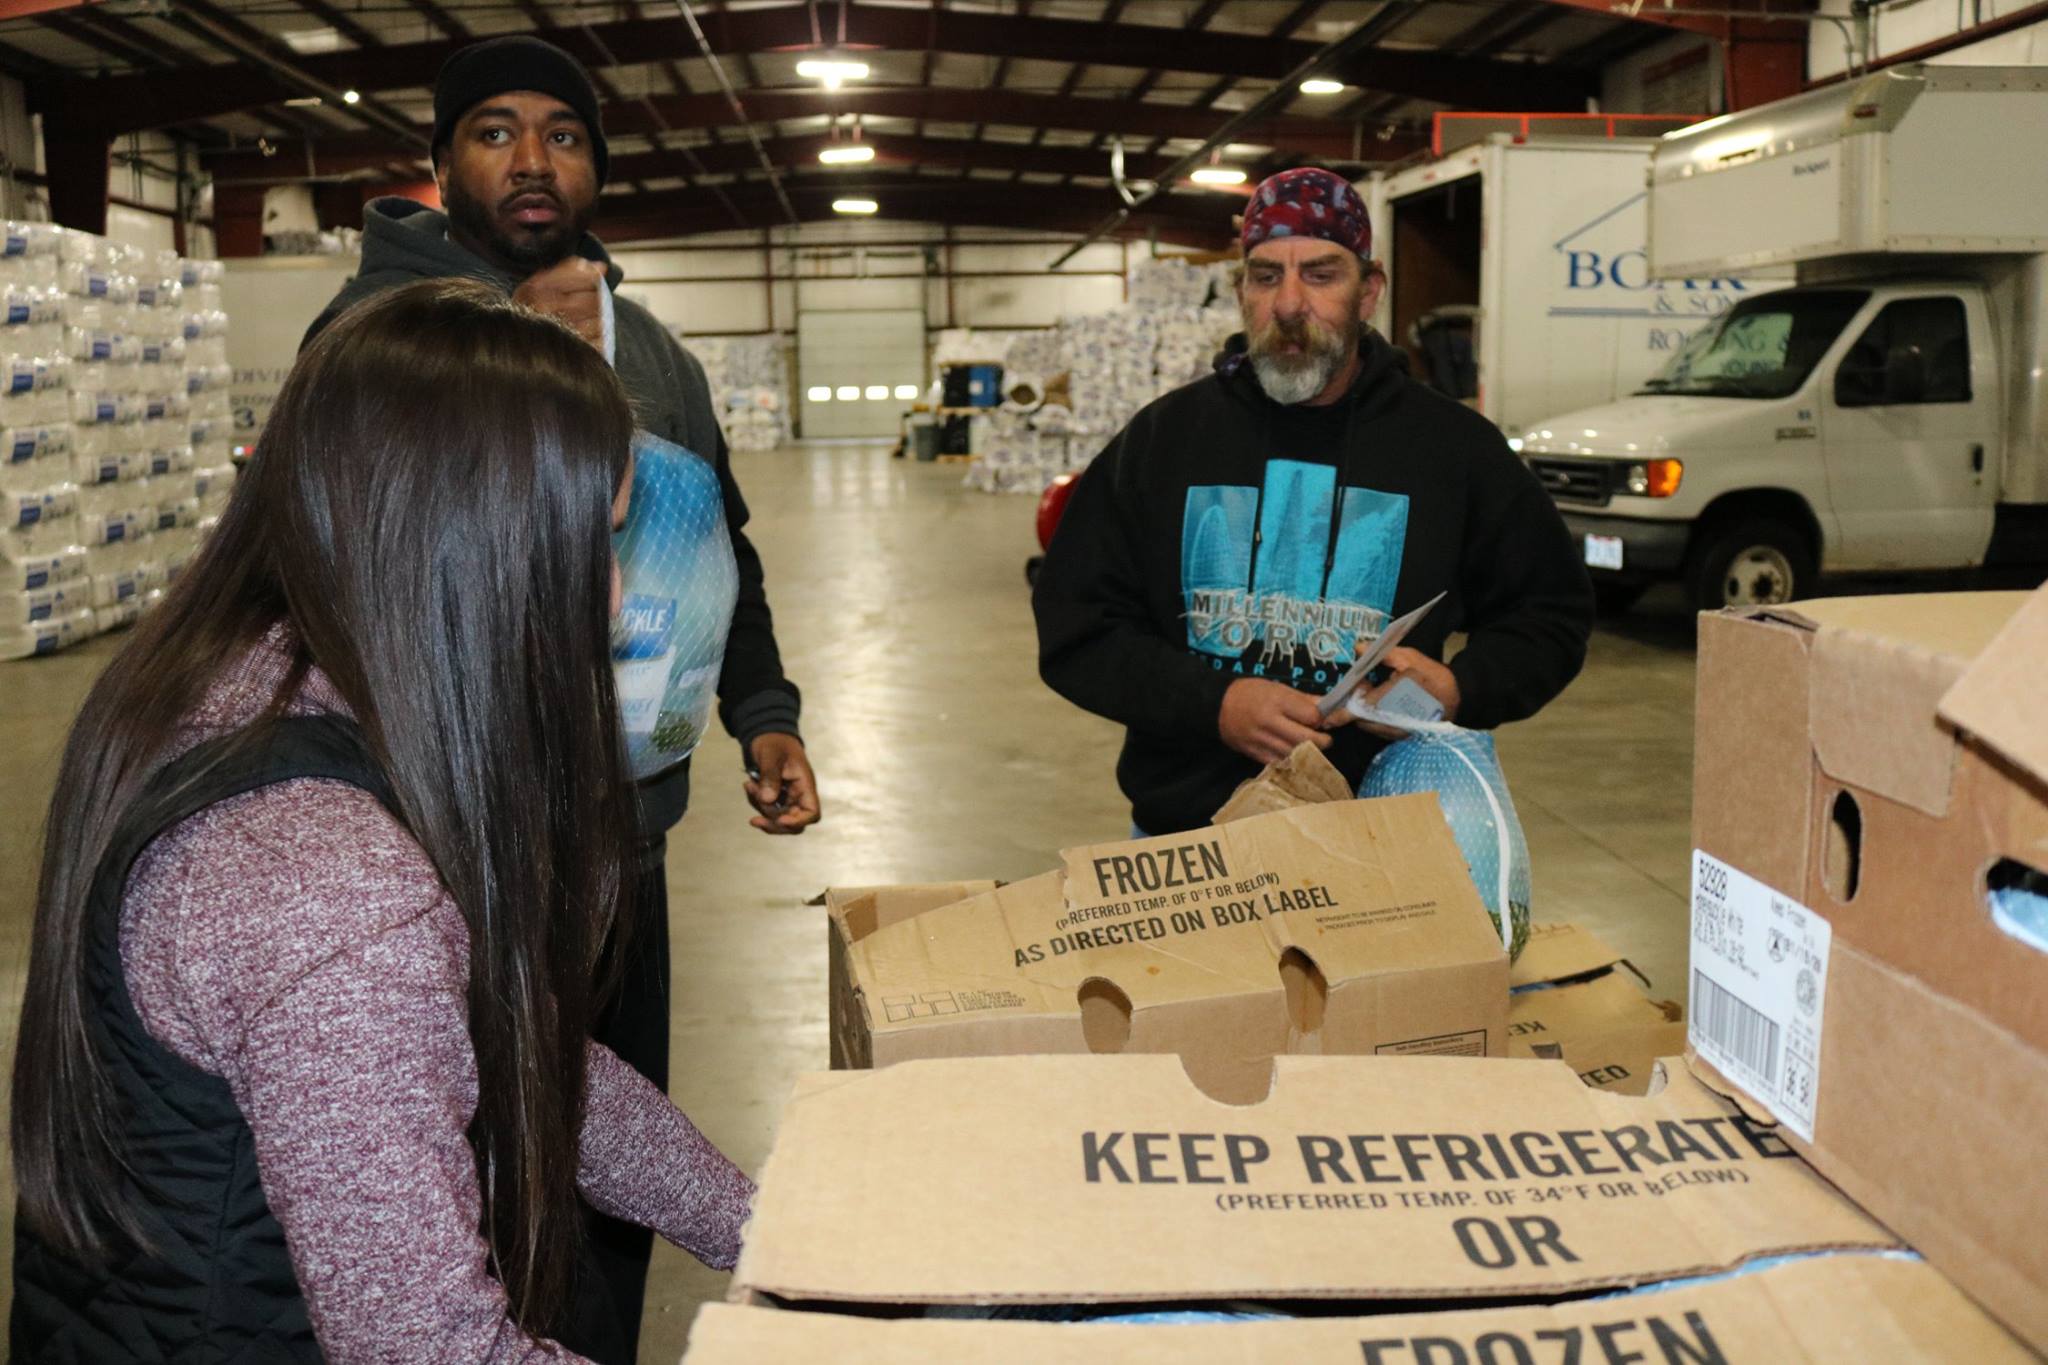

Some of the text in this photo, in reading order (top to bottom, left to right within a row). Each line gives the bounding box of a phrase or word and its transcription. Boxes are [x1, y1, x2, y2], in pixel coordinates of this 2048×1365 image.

[1192, 590, 1382, 635] MILLENNIUM
[1192, 615, 1382, 660] FORC
[1093, 840, 1228, 897] FROZEN
[1014, 885, 1339, 967] AS DIRECTED ON BOX LABEL
[1055, 903, 1131, 930] (PREFERRED
[1136, 895, 1170, 913] TEMP.
[1172, 891, 1188, 905] OF
[1215, 884, 1233, 898] OR
[1236, 871, 1280, 894] BELOW)
[1082, 1132, 1270, 1184] KEEP
[1216, 1168, 1749, 1211] (PREFERRED TEMP. OF 34°F OR BELOW)
[1452, 1216, 1582, 1269] OR
